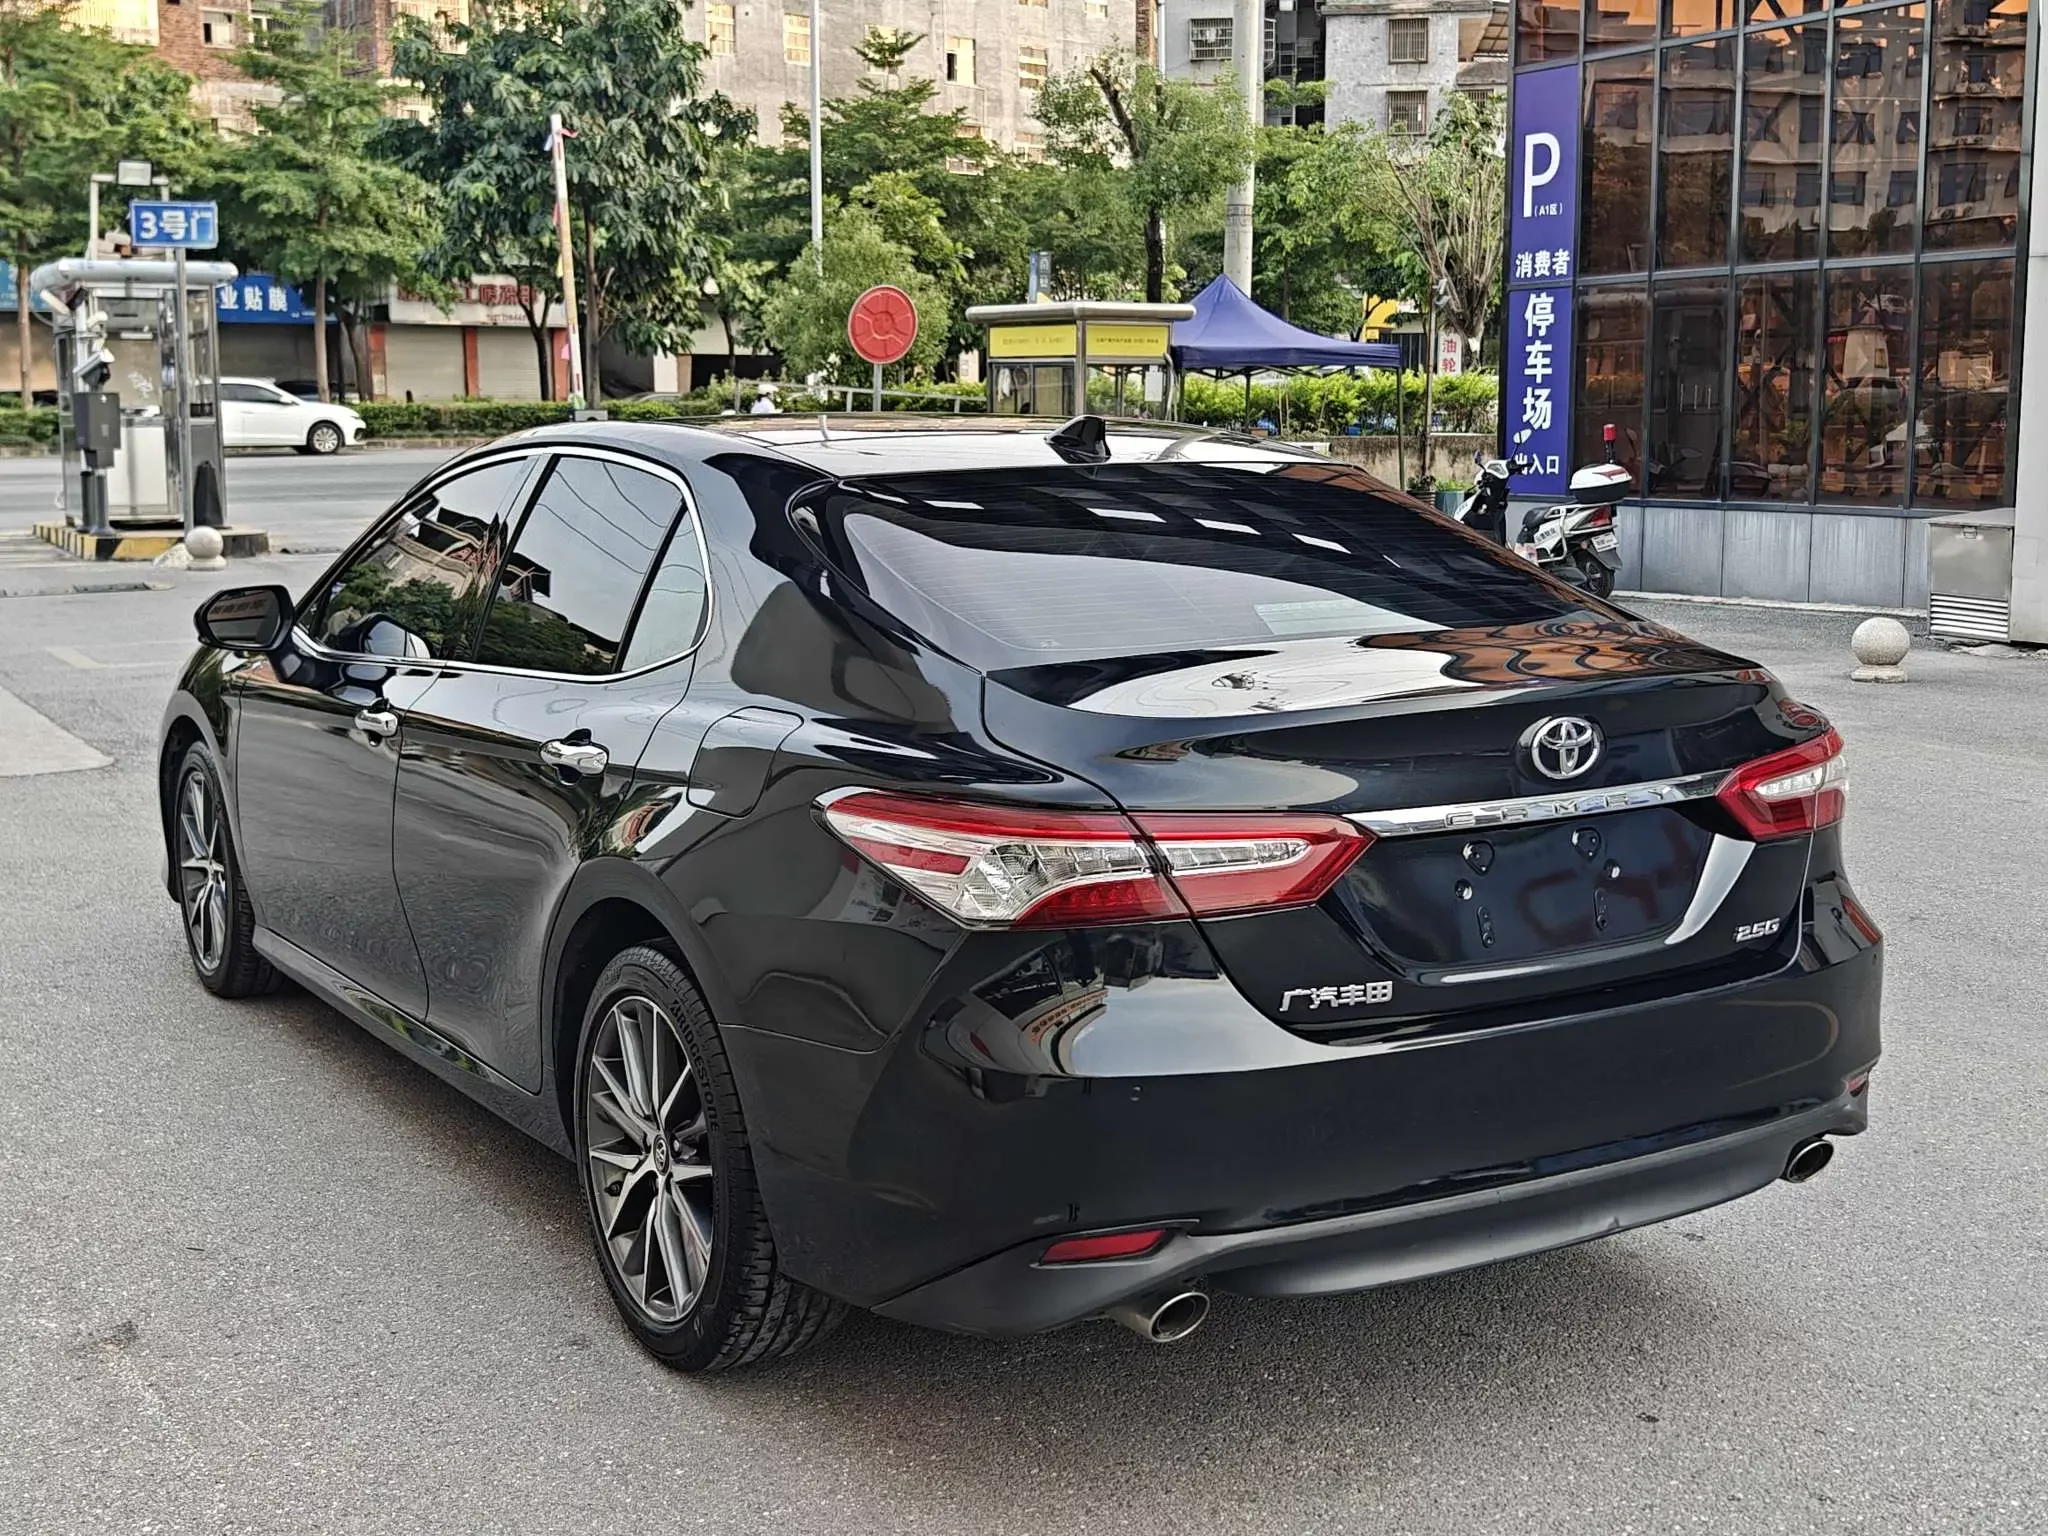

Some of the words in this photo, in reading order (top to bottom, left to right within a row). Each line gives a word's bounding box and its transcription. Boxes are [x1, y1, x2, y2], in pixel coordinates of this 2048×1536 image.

[1523, 132, 1561, 218] P
[140, 209, 214, 241] 3号门
[1515, 248, 1571, 279] 消费者
[1522, 291, 1555, 430] 停车场
[1514, 453, 1560, 476] 出入口
[1445, 783, 1665, 827] CAMRY
[1279, 980, 1391, 1011] 广汽丰田
